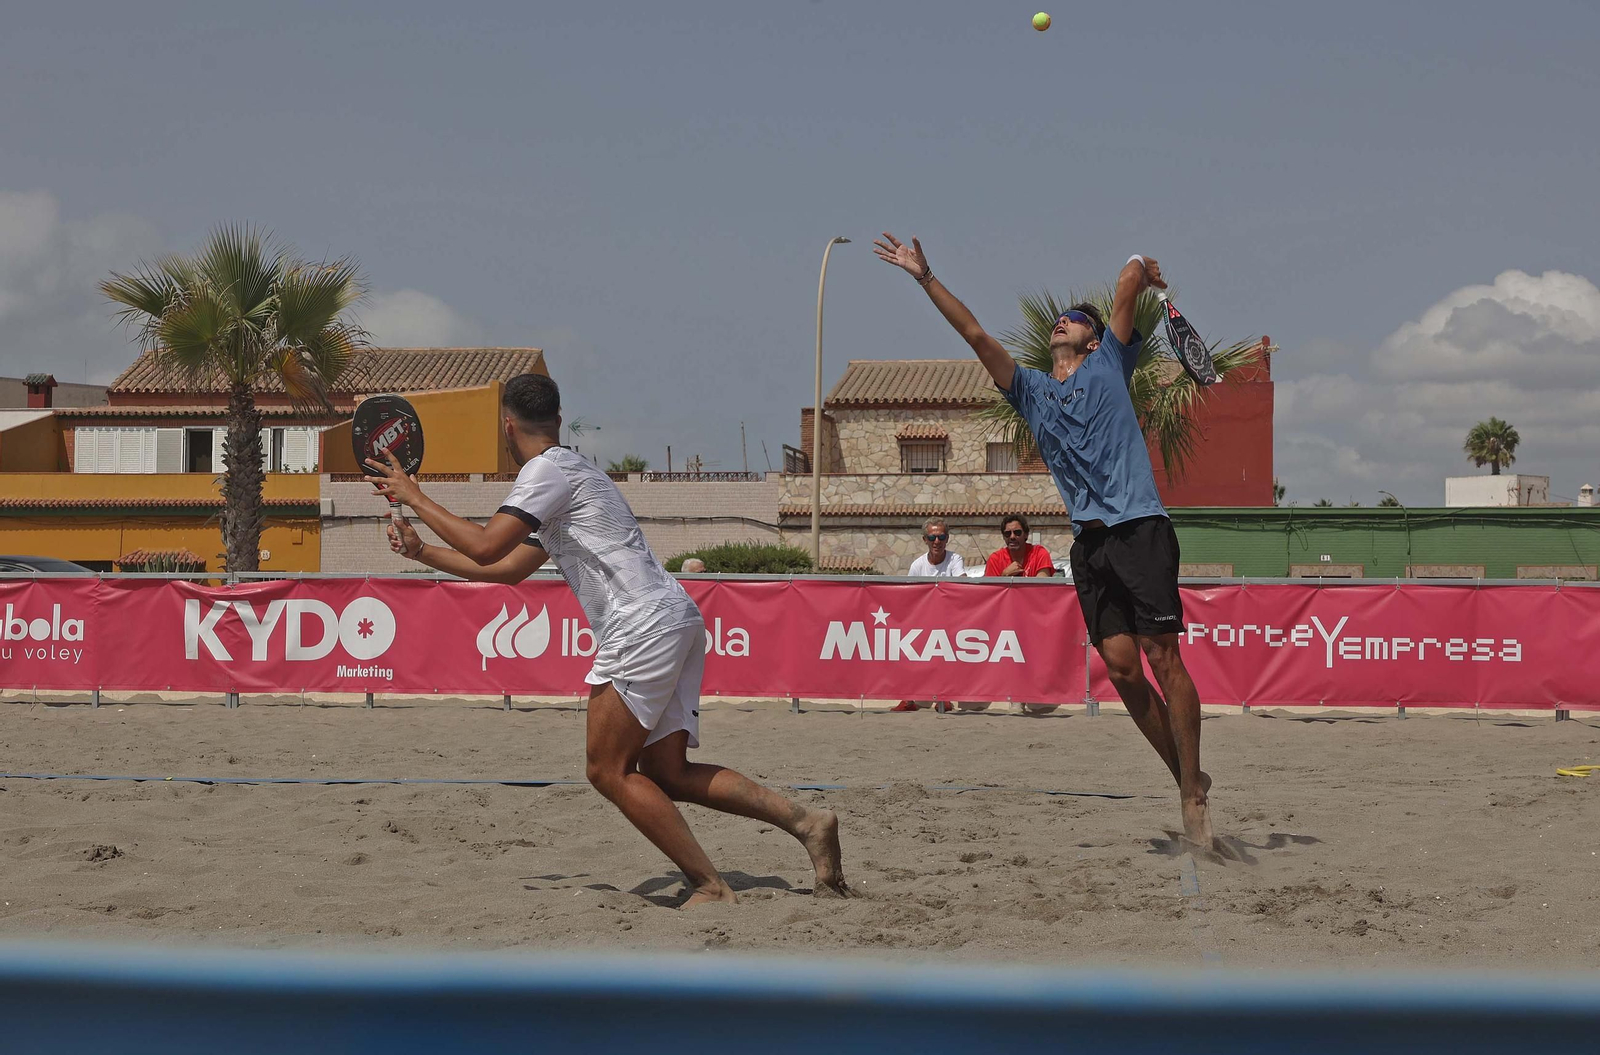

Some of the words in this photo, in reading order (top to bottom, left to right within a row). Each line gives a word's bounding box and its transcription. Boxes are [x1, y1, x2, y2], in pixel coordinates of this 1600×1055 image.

[372, 418, 405, 457] MBT
[402, 457, 420, 473] ILLER
[0, 603, 85, 642] bola
[184, 596, 397, 662] KYDO
[819, 605, 1026, 664] MIKASA
[24, 644, 83, 665] voley
[336, 664, 394, 681] Marketing
